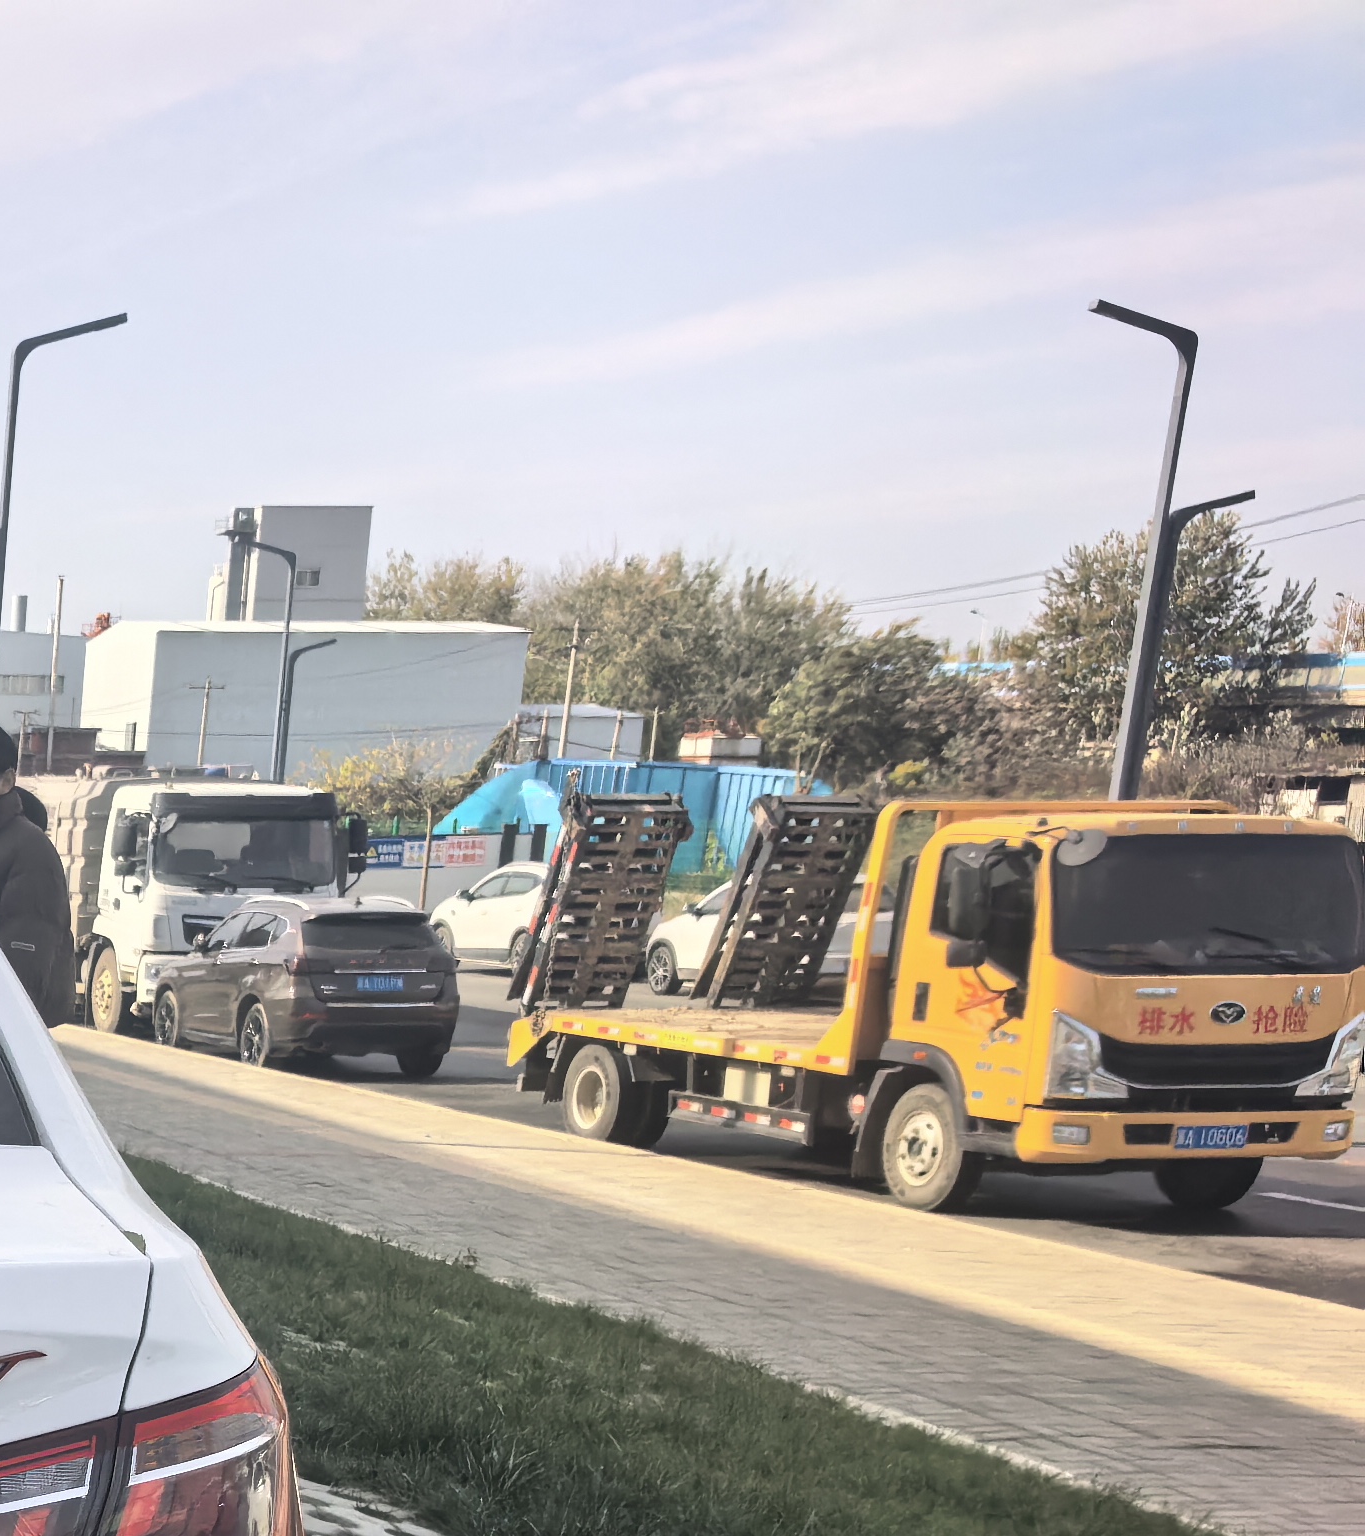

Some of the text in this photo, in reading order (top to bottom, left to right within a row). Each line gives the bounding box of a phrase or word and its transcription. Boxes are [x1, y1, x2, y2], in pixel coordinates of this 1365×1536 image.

[1138, 1003, 1308, 1036] 排水 抢险
[1176, 1127, 1245, 1146] A10606
